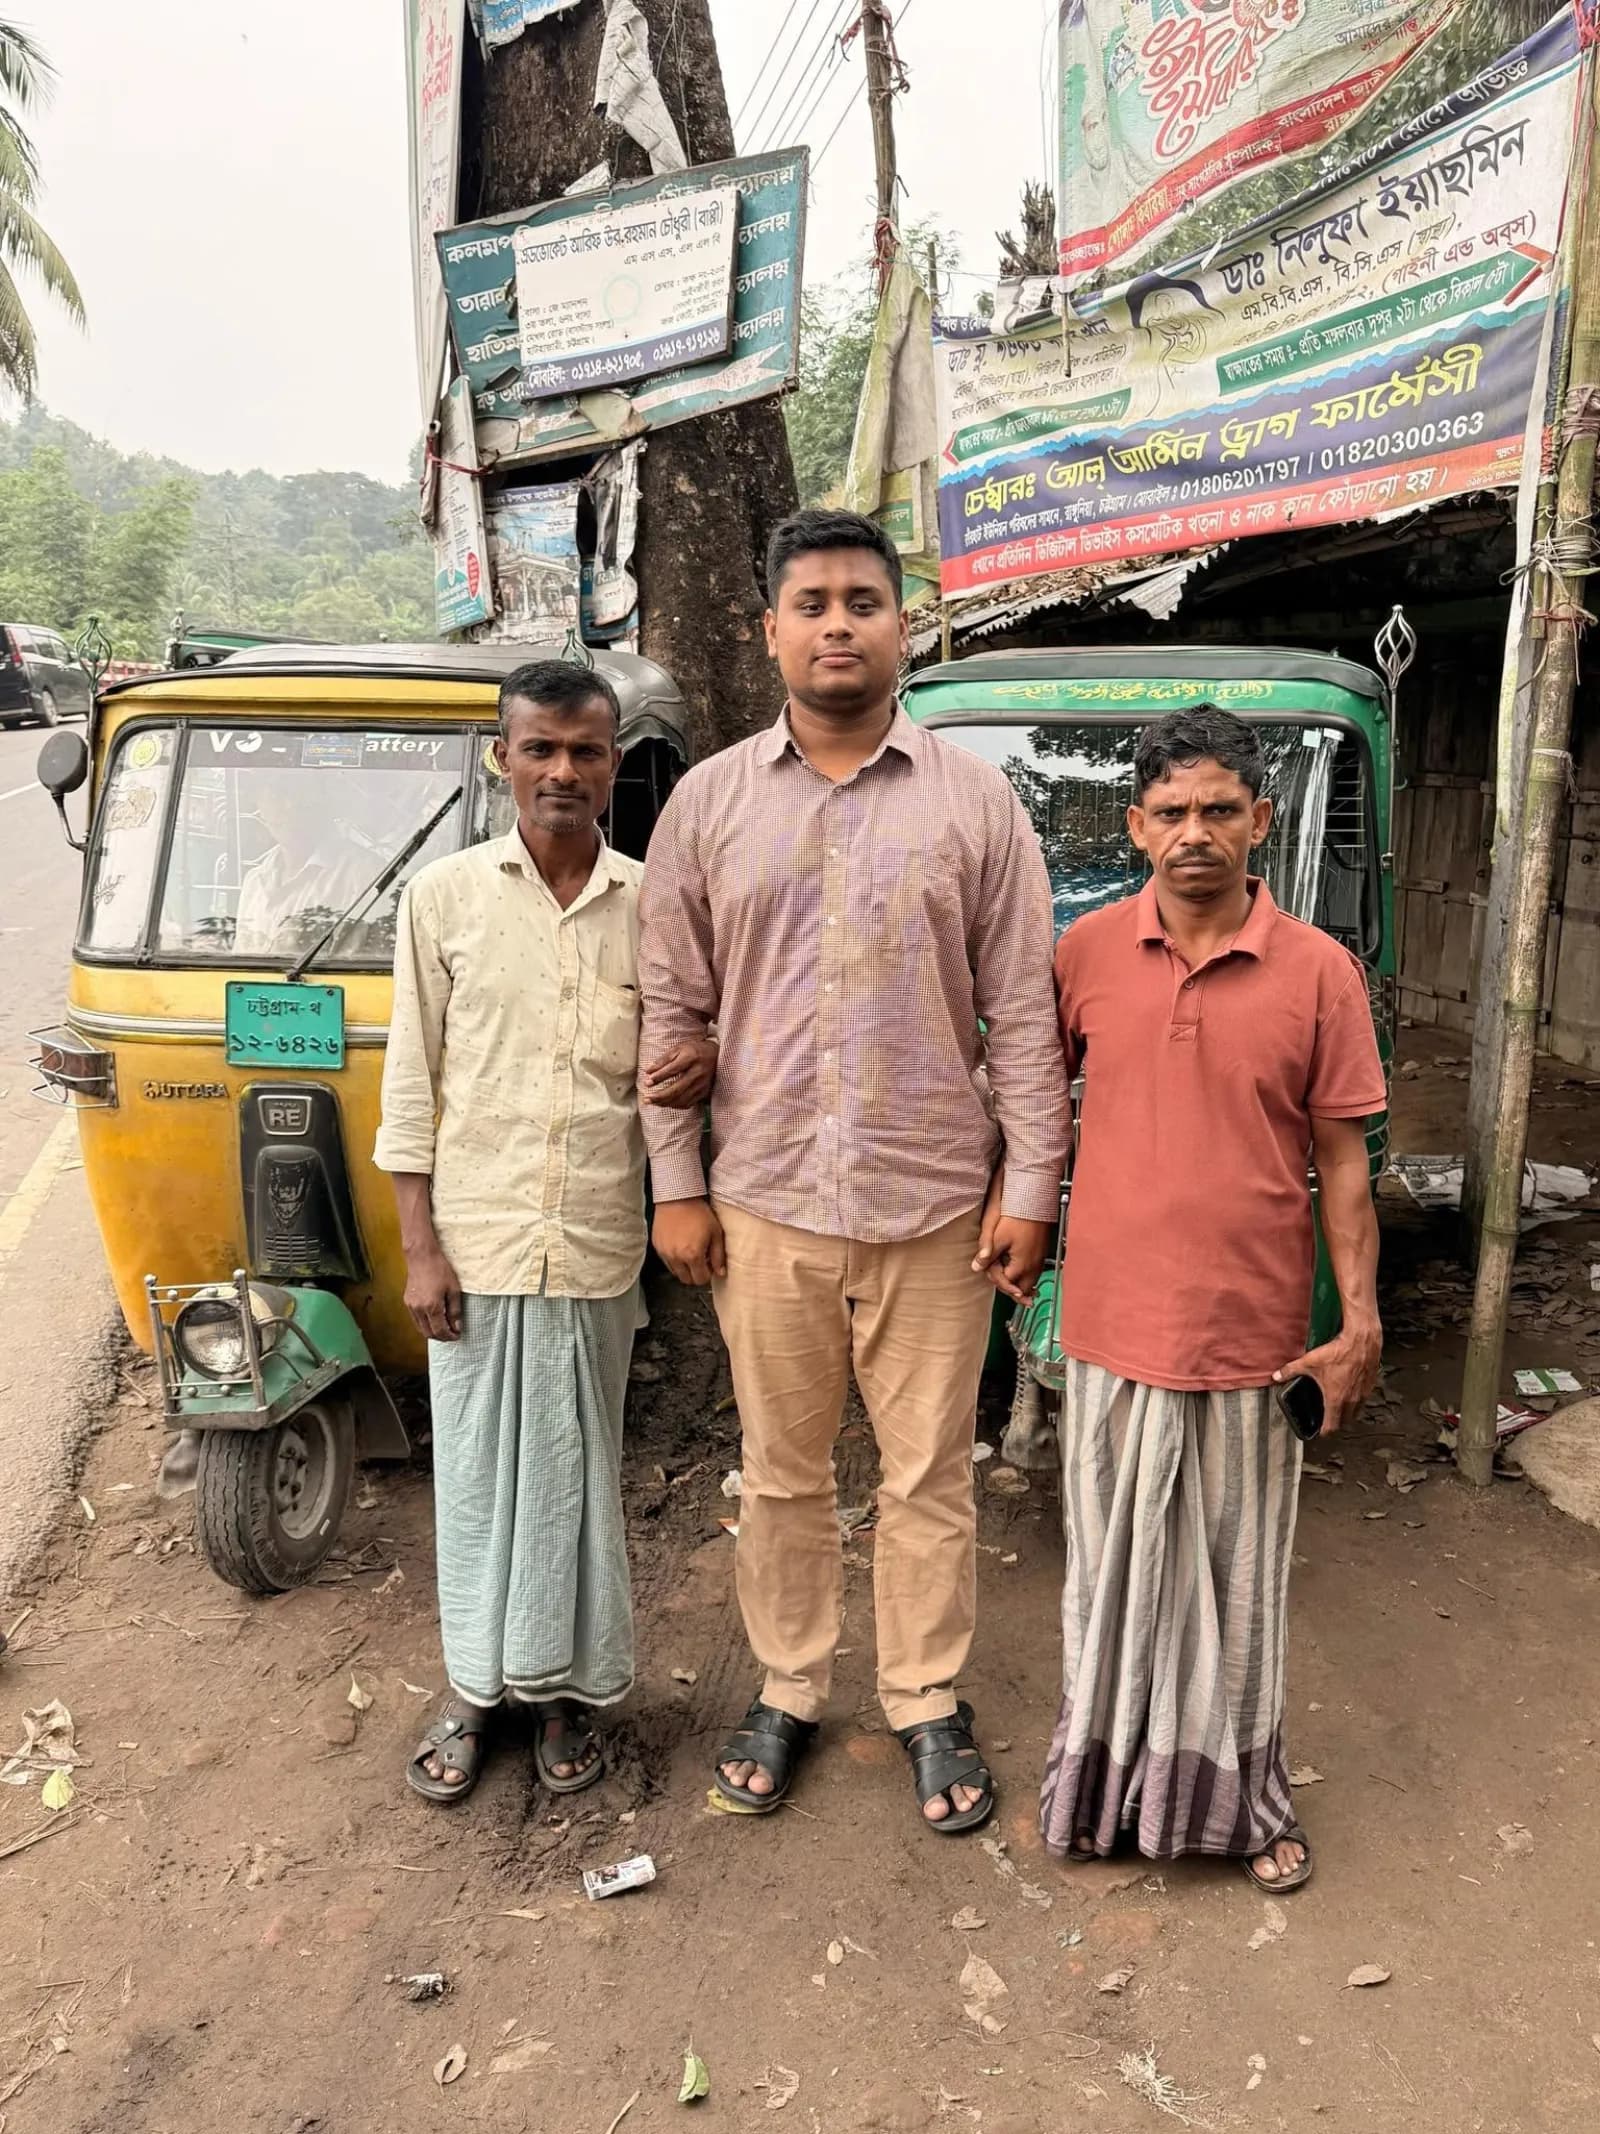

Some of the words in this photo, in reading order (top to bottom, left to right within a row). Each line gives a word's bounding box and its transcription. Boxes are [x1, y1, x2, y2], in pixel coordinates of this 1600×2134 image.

[1400, 96, 1456, 142] রোগে
[1458, 57, 1529, 102] অভিজ্ঞ
[1271, 196, 1370, 275] নিলুফা
[1377, 117, 1532, 223] ইয়াছমিন
[570, 226, 602, 255] আরিফ
[659, 205, 693, 242] চৌধুরী
[1298, 330, 1322, 358] প্রতি
[1322, 317, 1367, 351] মঙ্গলবার
[1367, 309, 1393, 346] দুপুর
[1396, 295, 1416, 326] ২টা
[1418, 289, 1449, 322] থেকে
[1448, 272, 1484, 312] বিকাল
[949, 349, 972, 373] ডাঃ
[1108, 429, 1212, 474] আমিন
[1219, 407, 1302, 463] ড্রাগ
[1180, 455, 1301, 500] 01806201797
[1320, 411, 1486, 471] 01820300363
[996, 543, 1033, 571] প্রতিদিন
[1033, 535, 1078, 564] ডিজিটাল
[1079, 527, 1123, 554] ডিভাইস
[1124, 514, 1185, 547] কসমেটিক
[1229, 510, 1242, 529] ও
[1245, 503, 1277, 526] নাক
[364, 736, 445, 757] attery
[230, 1031, 340, 1056] ১২-৬৪২৬
[268, 1108, 302, 1128] RE
